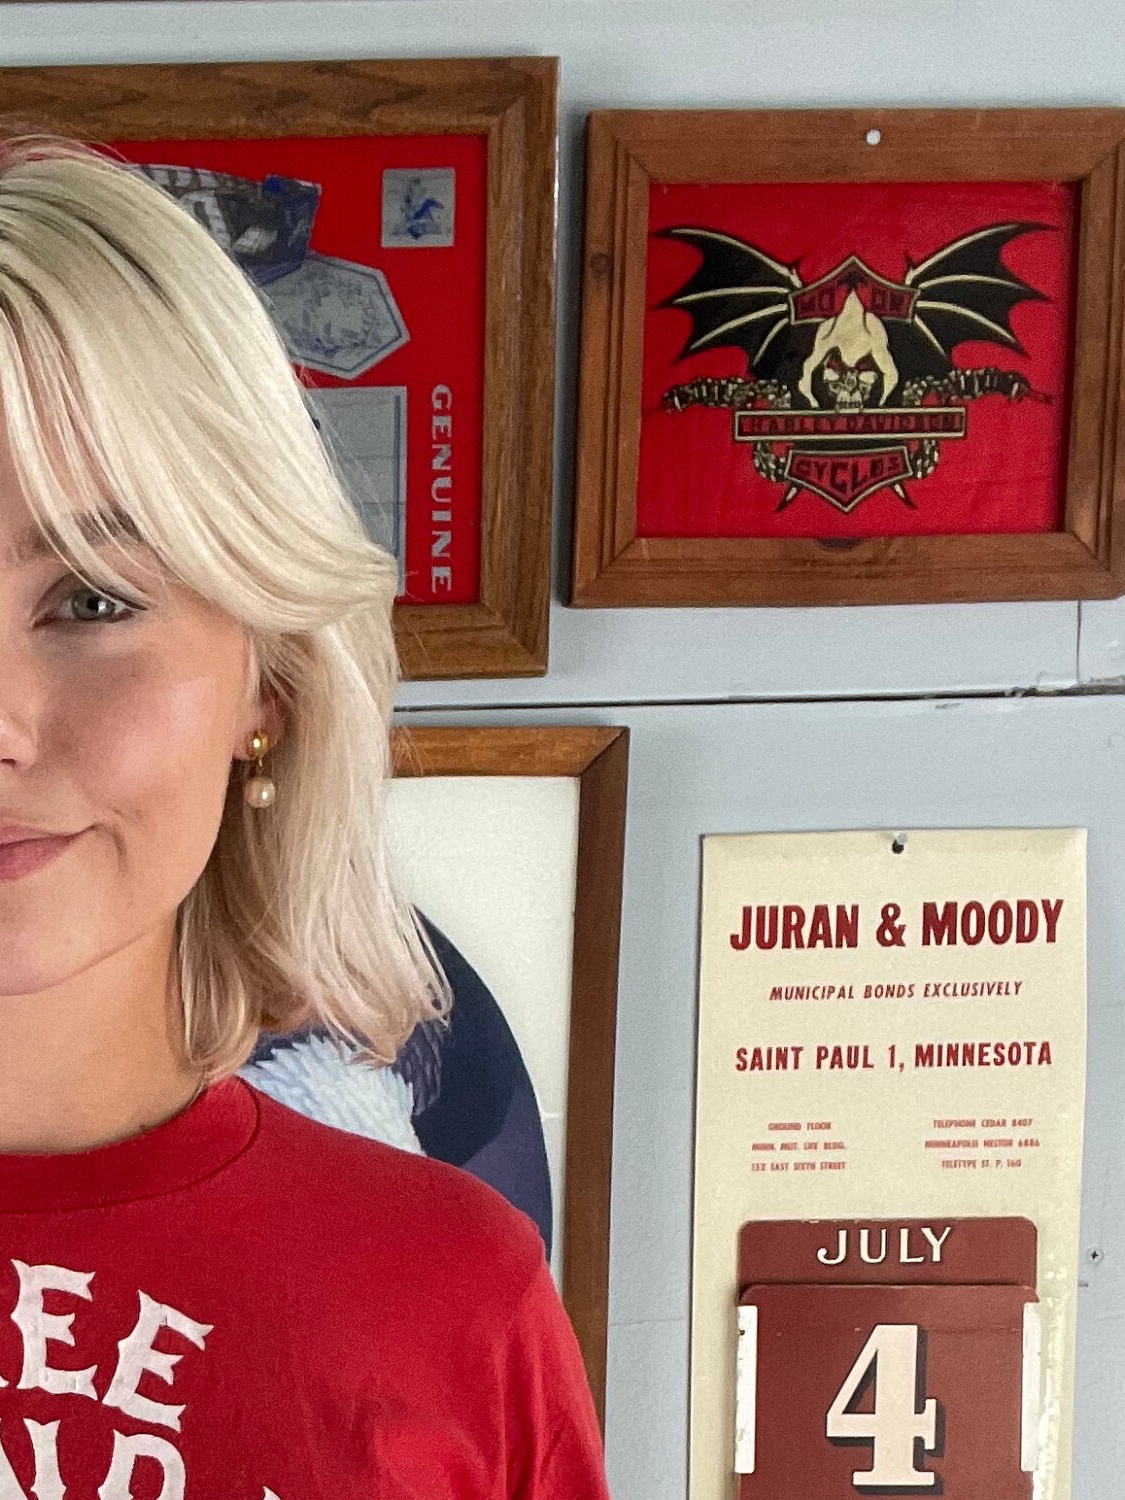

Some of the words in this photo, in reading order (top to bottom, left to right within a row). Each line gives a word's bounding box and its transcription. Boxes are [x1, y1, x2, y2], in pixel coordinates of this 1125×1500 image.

[431, 384, 452, 593] GENUINE
[730, 904, 859, 951] JURAN
[876, 903, 906, 947] &
[922, 899, 1064, 946] MOODY
[769, 985, 854, 1001] MUNICIPAL
[864, 983, 914, 999] BONDS
[923, 981, 1022, 998] EXCLUSIVELY
[735, 1045, 804, 1071] SAINT
[816, 1045, 875, 1070] PAUL
[888, 1044, 905, 1073] 1,
[914, 1041, 1053, 1068] MINNESOTA
[816, 1226, 952, 1265] JULY
[826, 1323, 945, 1495] 4
